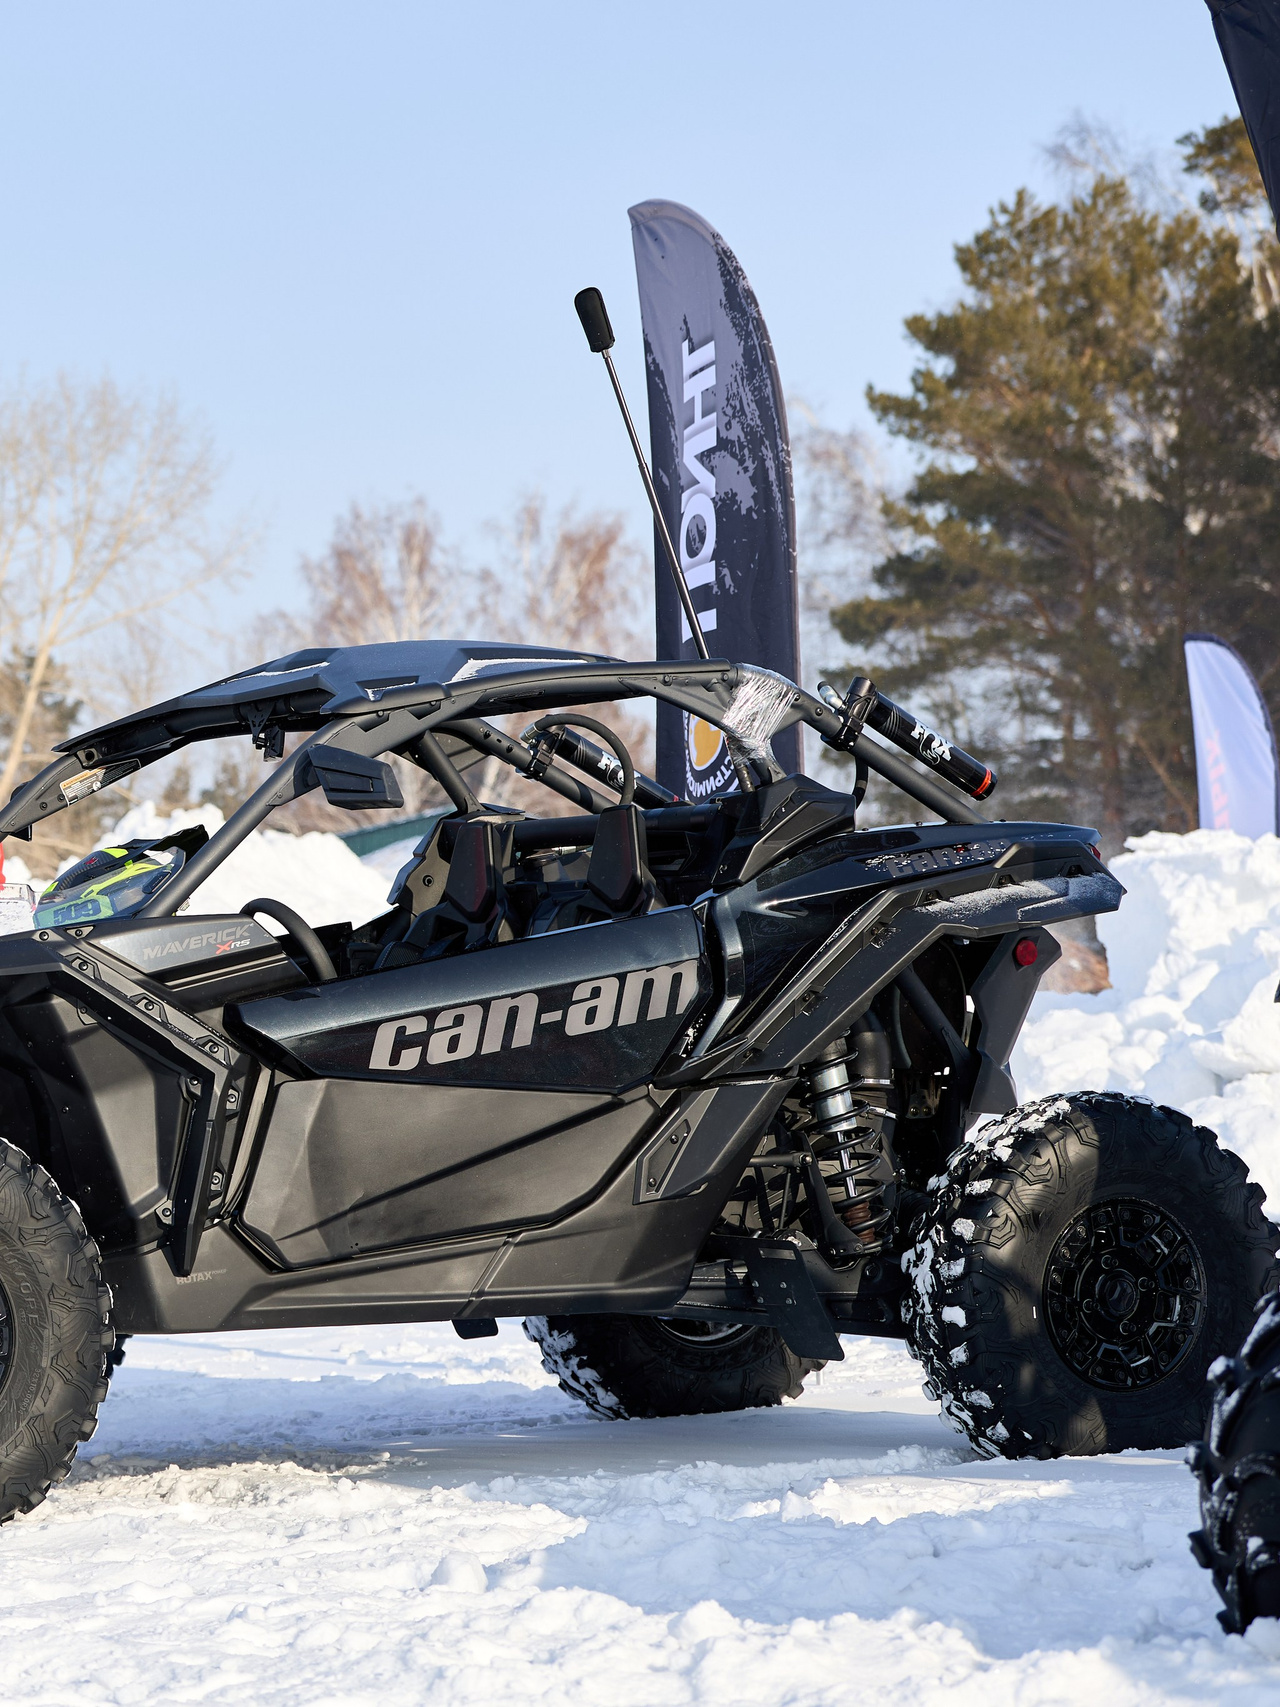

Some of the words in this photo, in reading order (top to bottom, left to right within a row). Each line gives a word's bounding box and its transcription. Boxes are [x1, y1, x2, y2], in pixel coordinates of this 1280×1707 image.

[679, 338, 717, 645] ПОИНТ
[910, 719, 954, 763] FOX
[53, 899, 102, 924] 509
[142, 924, 251, 960] MAVERICK
[369, 960, 698, 1071] can-am
